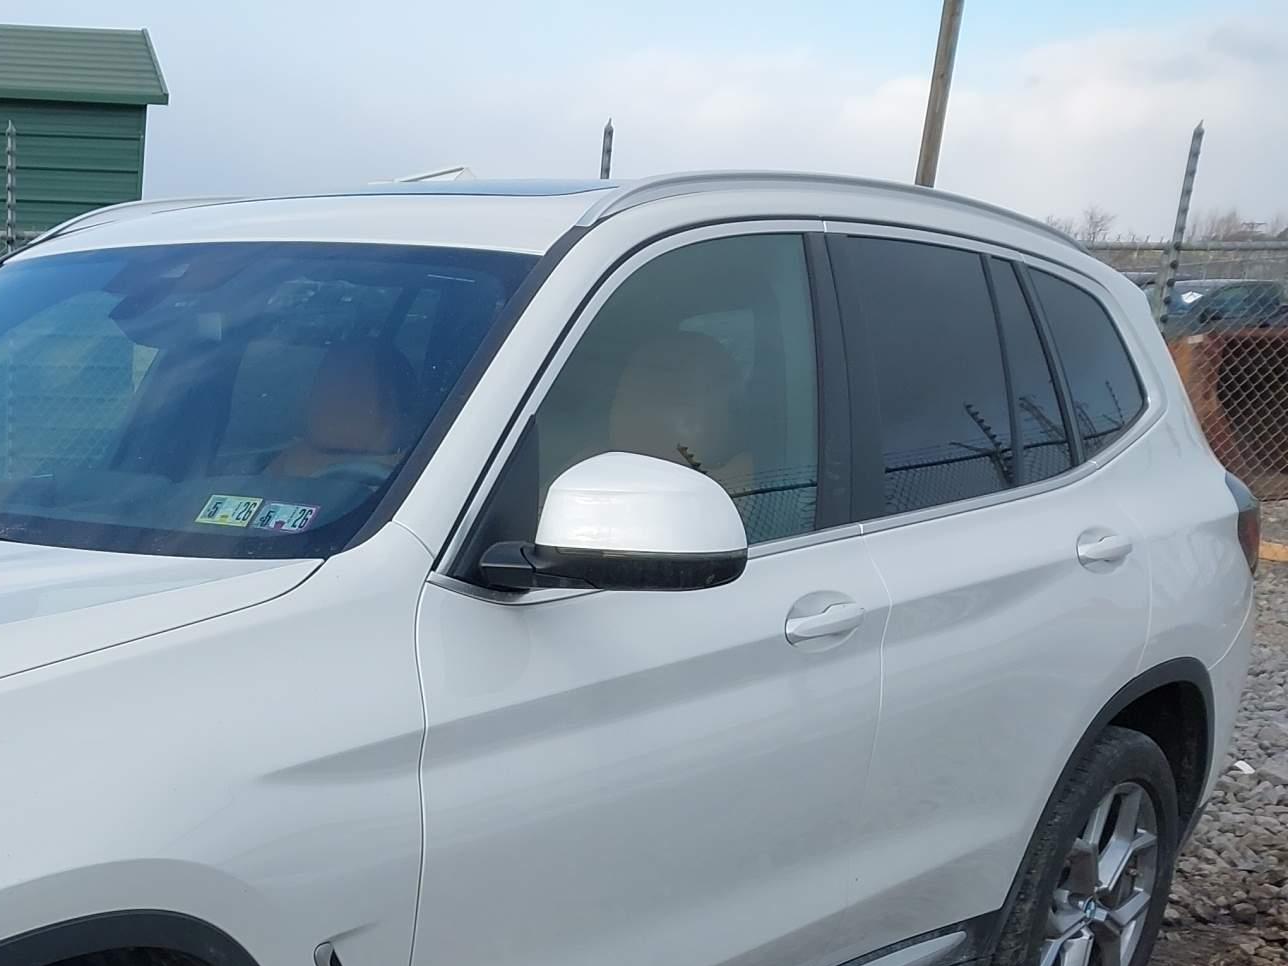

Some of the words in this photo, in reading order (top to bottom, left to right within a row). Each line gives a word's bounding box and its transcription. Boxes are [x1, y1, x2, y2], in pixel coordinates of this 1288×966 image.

[207, 501, 223, 518] 5
[235, 501, 258, 522] 26
[291, 508, 313, 529] 26
